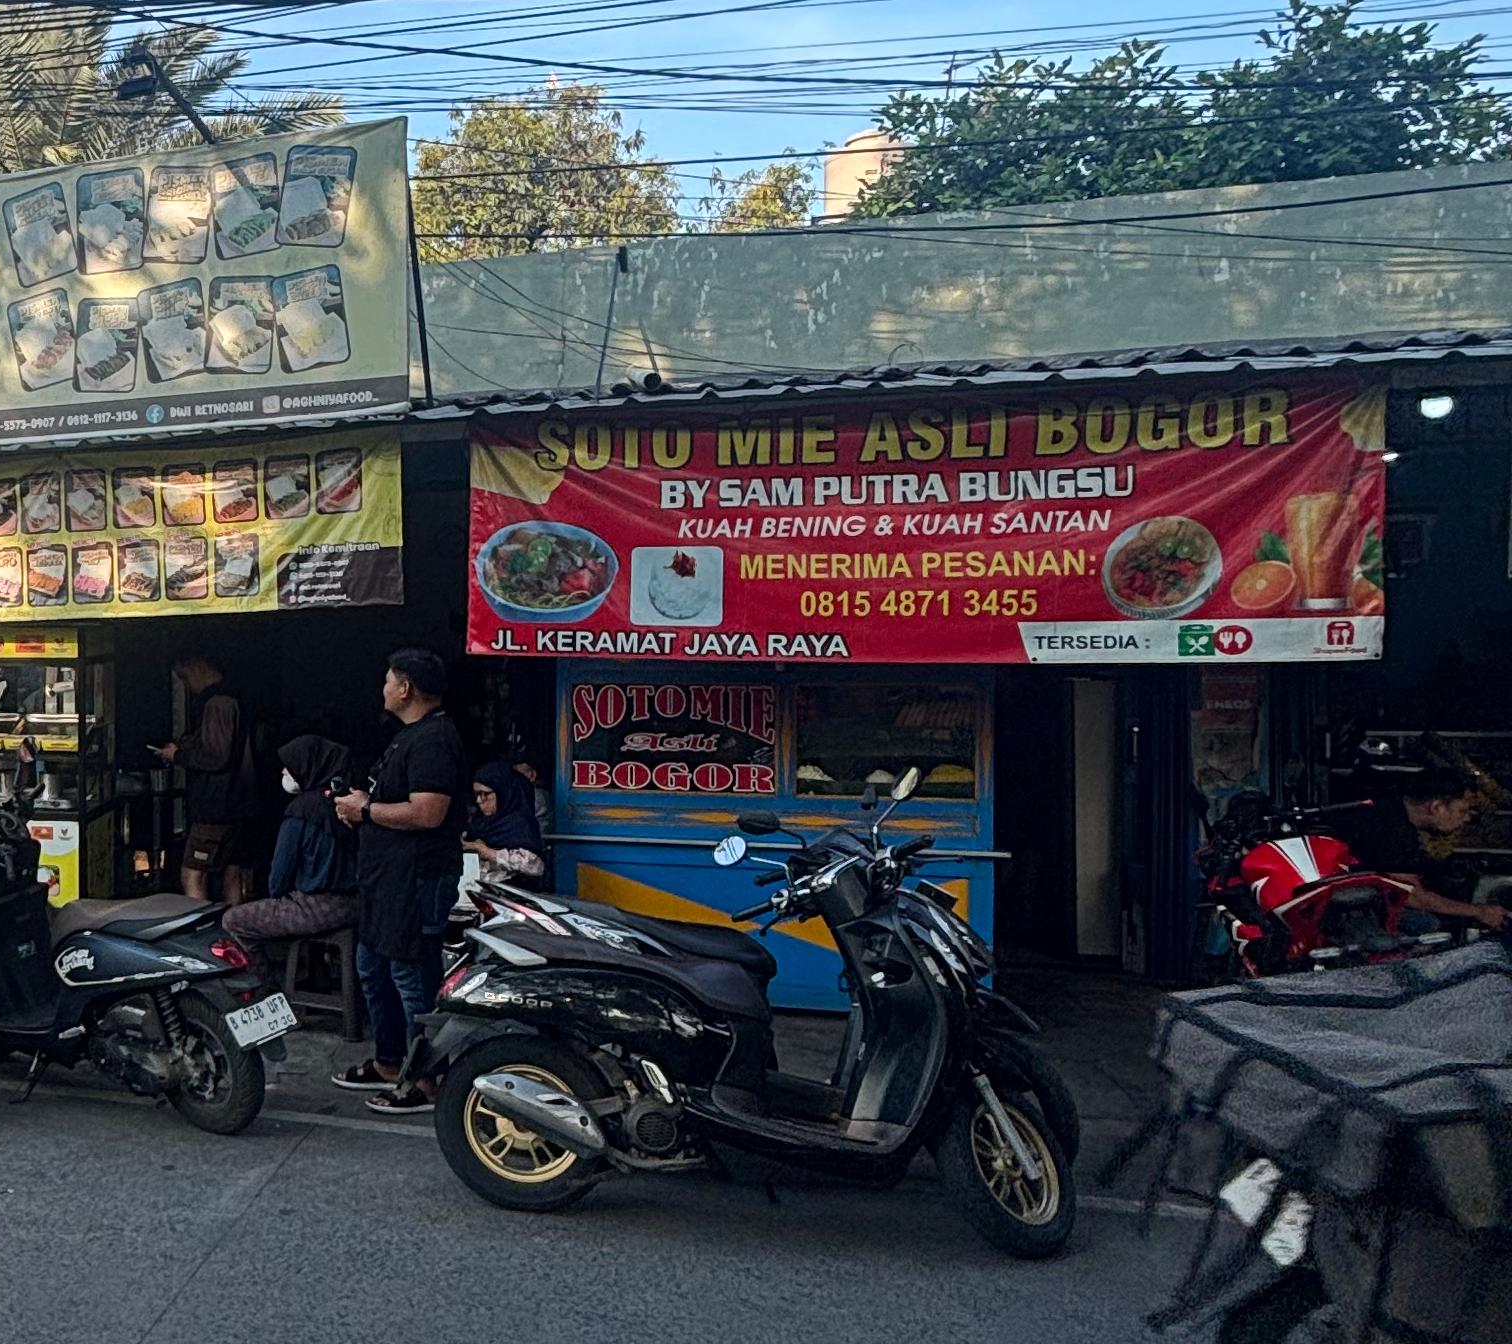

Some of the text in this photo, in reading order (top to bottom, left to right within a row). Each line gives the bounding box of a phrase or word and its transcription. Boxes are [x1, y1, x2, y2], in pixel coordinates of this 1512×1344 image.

[169, 405, 192, 418] DWI
[194, 400, 254, 416] RETNOSARI
[534, 386, 1292, 472] SOTO MIE ASLI BOGOR
[660, 464, 1136, 510] BY SAM PUTRA BUNGSU
[677, 509, 1112, 539] KUAH BENING & KUAH SANTAN
[738, 548, 1097, 581] MENERIMA PESANAN:
[799, 587, 1039, 618] 0815 4871 3455
[490, 629, 850, 658] JL. KERAMAT JAYA RAYA
[1034, 634, 1140, 651] TERSEDIA
[620, 732, 718, 752] Asli
[572, 760, 775, 793] BOGOR
[229, 1016, 239, 1031] B
